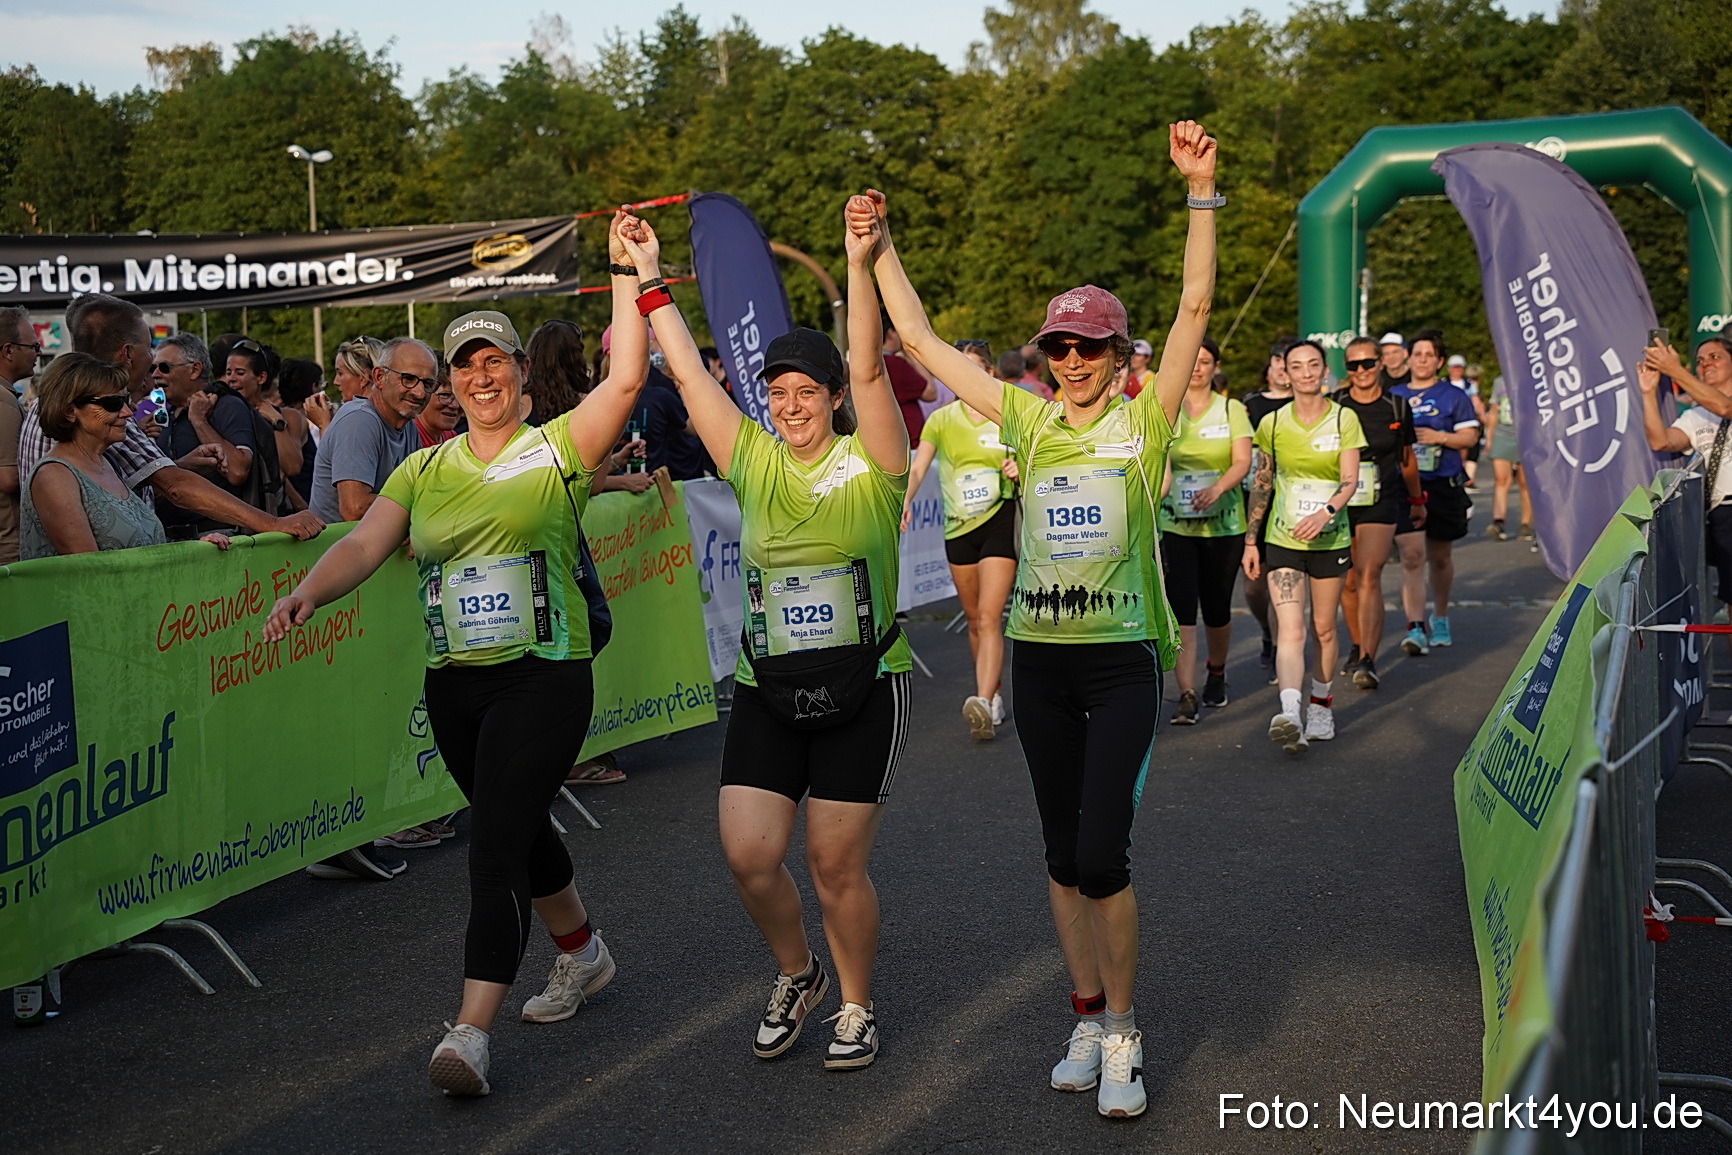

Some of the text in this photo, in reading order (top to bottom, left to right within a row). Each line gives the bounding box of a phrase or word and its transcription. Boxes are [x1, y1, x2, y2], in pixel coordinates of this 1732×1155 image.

[124, 252, 415, 292] Miteinander.
[487, 275, 505, 286] der
[450, 319, 503, 337] adidas
[962, 487, 989, 501] 1335
[1046, 505, 1102, 528] 1386
[1046, 530, 1109, 542] Dagmar Weber
[156, 568, 265, 652] Gesunde
[458, 592, 512, 616] 1332
[781, 603, 834, 626] 1329
[458, 615, 520, 629] Sabrina Göhring
[537, 609, 545, 636] HILTL
[790, 626, 834, 639] Anja Ehard
[860, 618, 869, 645] HILTL
[97, 786, 366, 916] www.firmenlauf-oberpfalz.de
